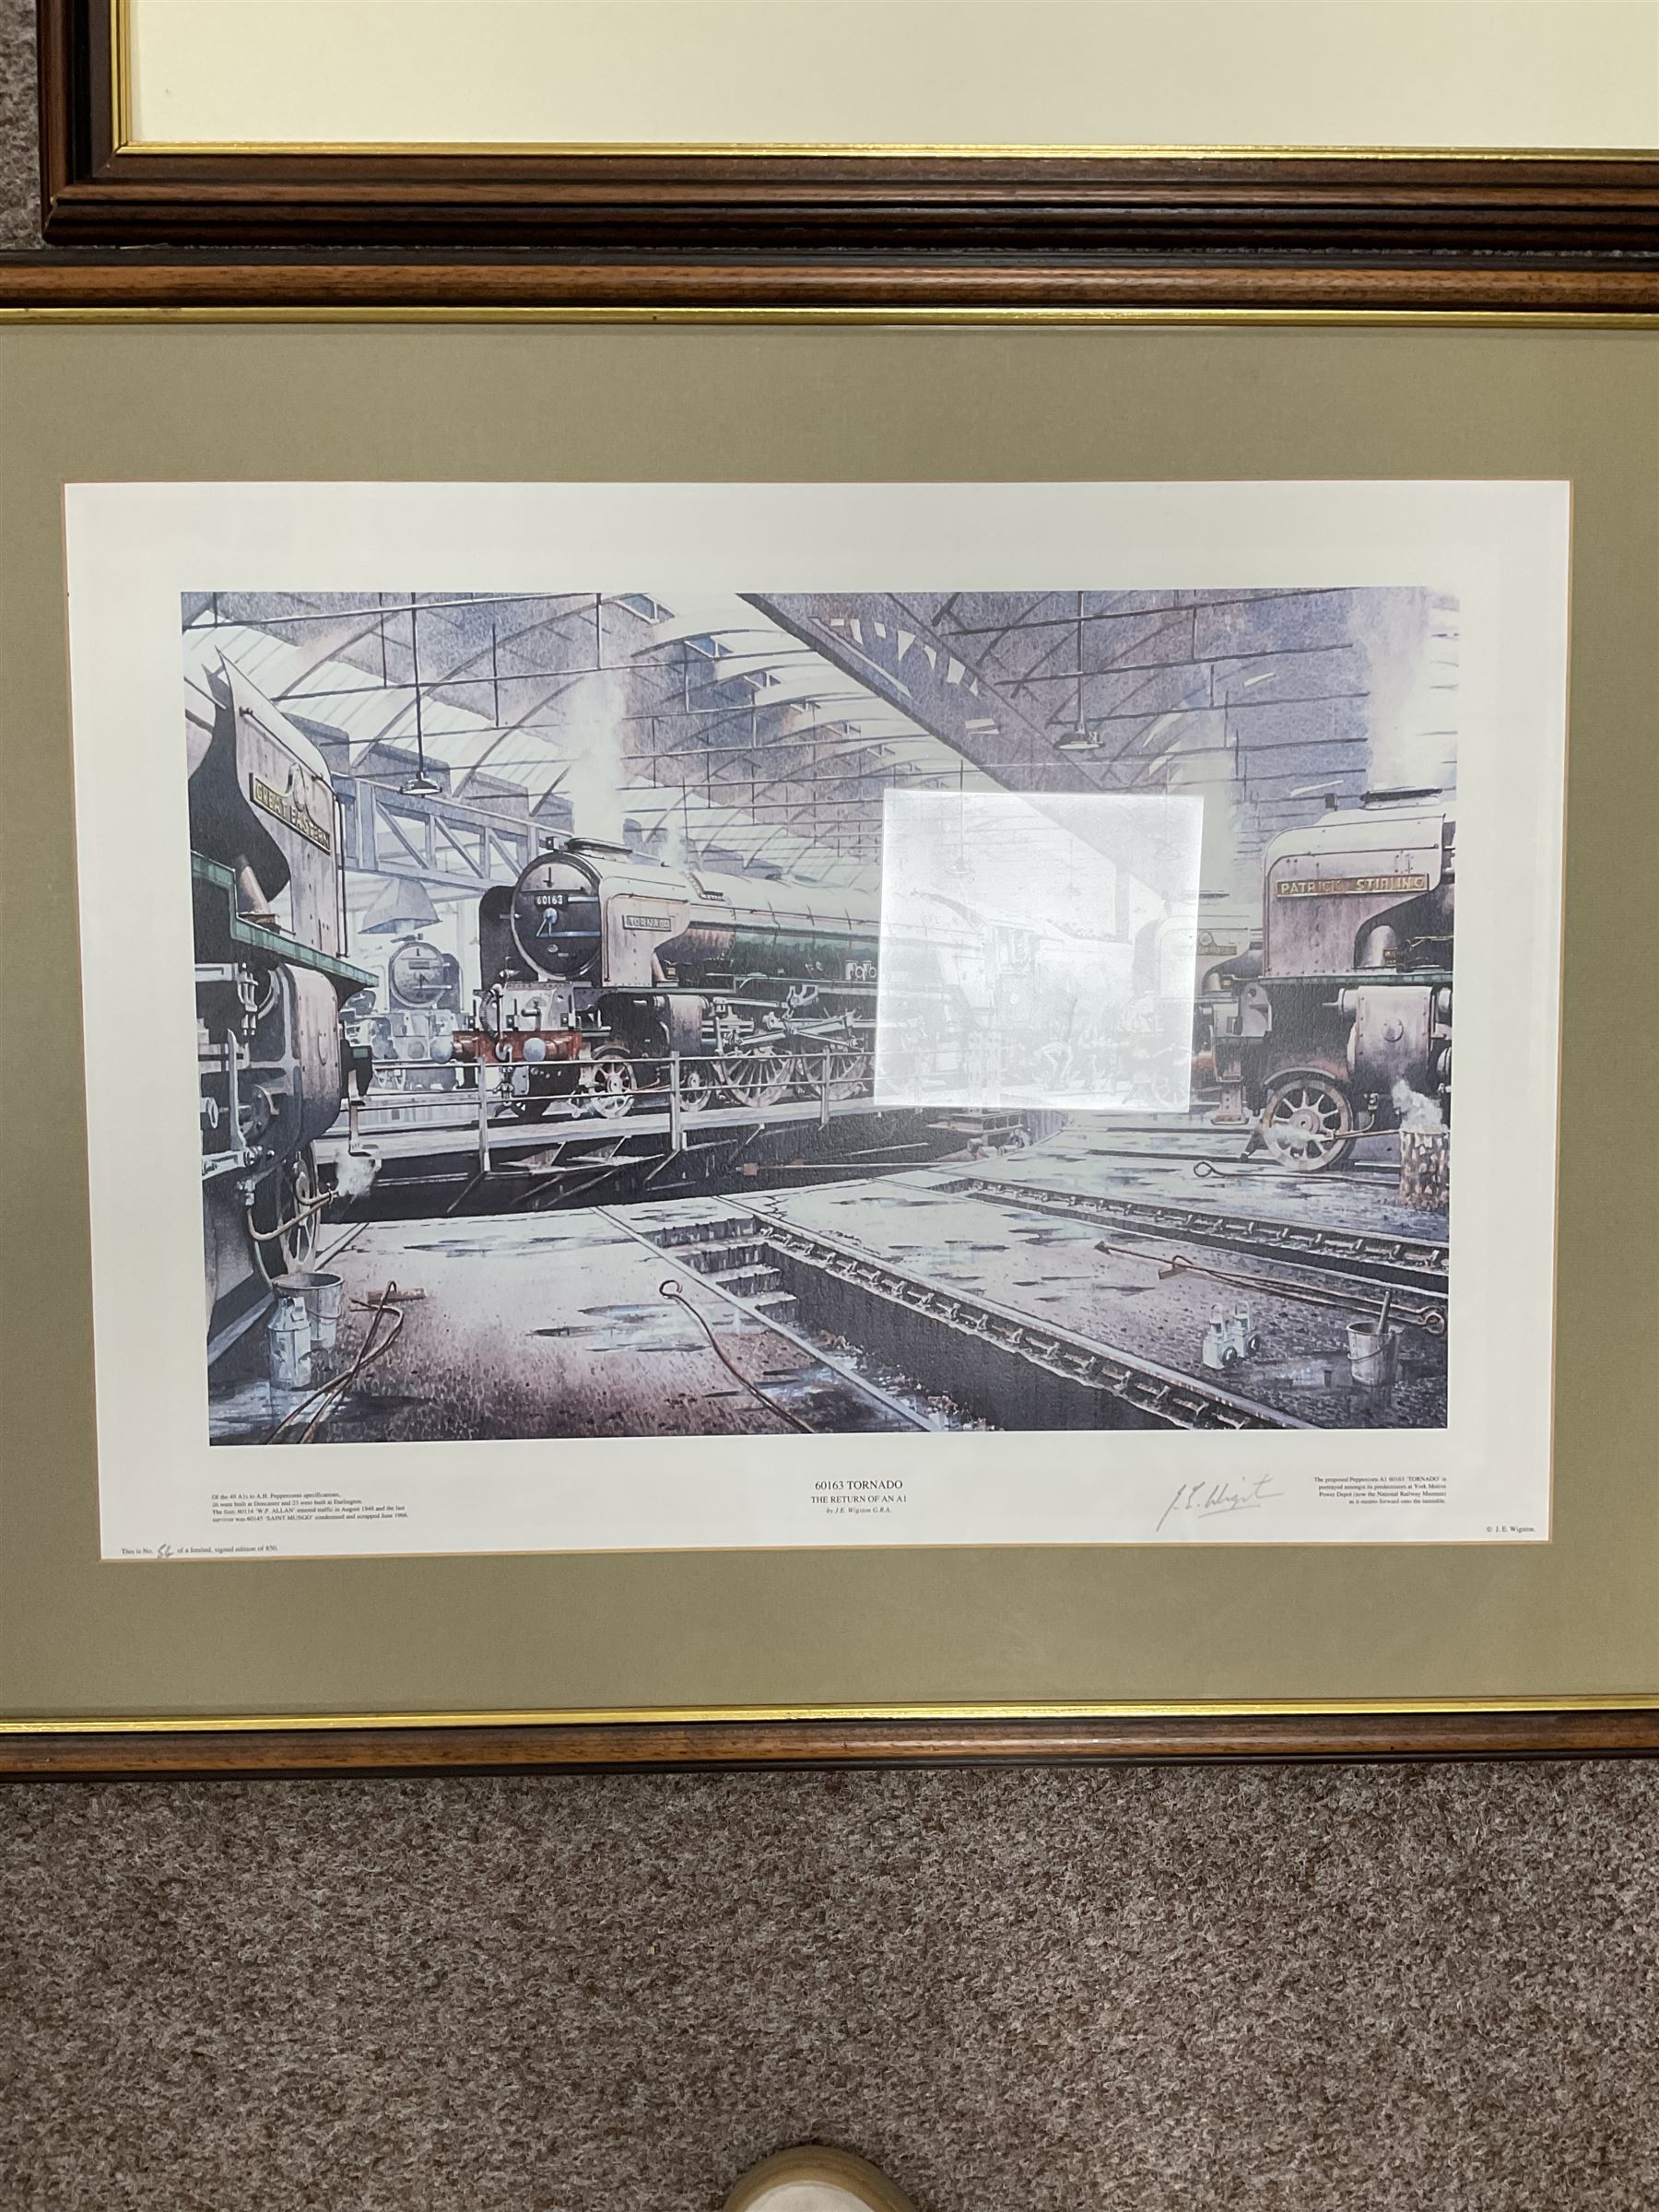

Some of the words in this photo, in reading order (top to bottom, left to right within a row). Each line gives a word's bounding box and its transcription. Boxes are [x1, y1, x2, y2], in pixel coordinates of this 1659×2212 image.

[1356, 877, 1424, 891] STIRLING
[536, 895, 563, 905] 60163
[815, 1481, 844, 1490] 60163
[847, 1480, 903, 1490] TORNADO
